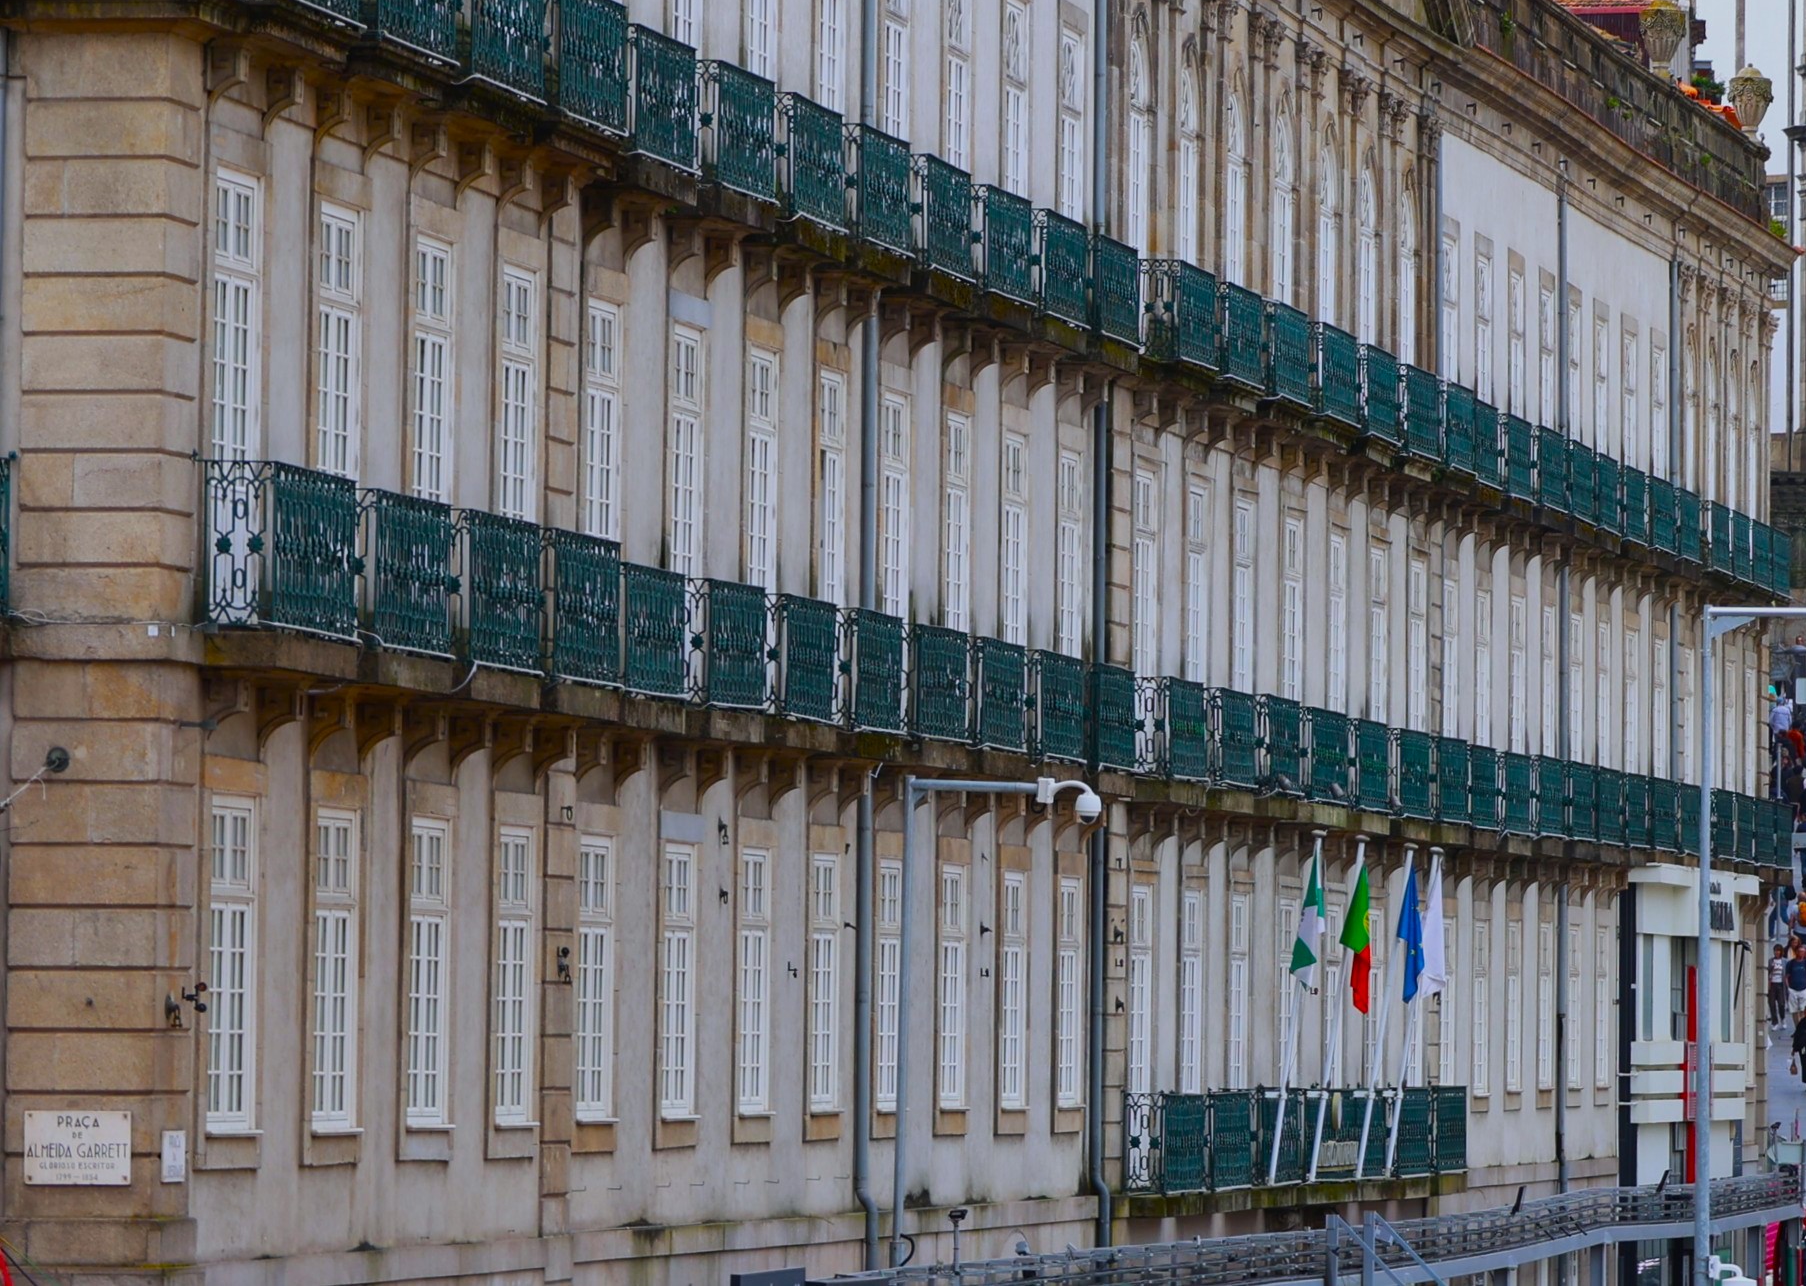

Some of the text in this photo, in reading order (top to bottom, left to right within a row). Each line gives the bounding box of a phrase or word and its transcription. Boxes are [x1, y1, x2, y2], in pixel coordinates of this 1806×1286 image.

[57, 1115, 100, 1129] PRAÇA
[72, 1131, 82, 1139] DE
[27, 1143, 128, 1158] ALMEIDA GARRETT
